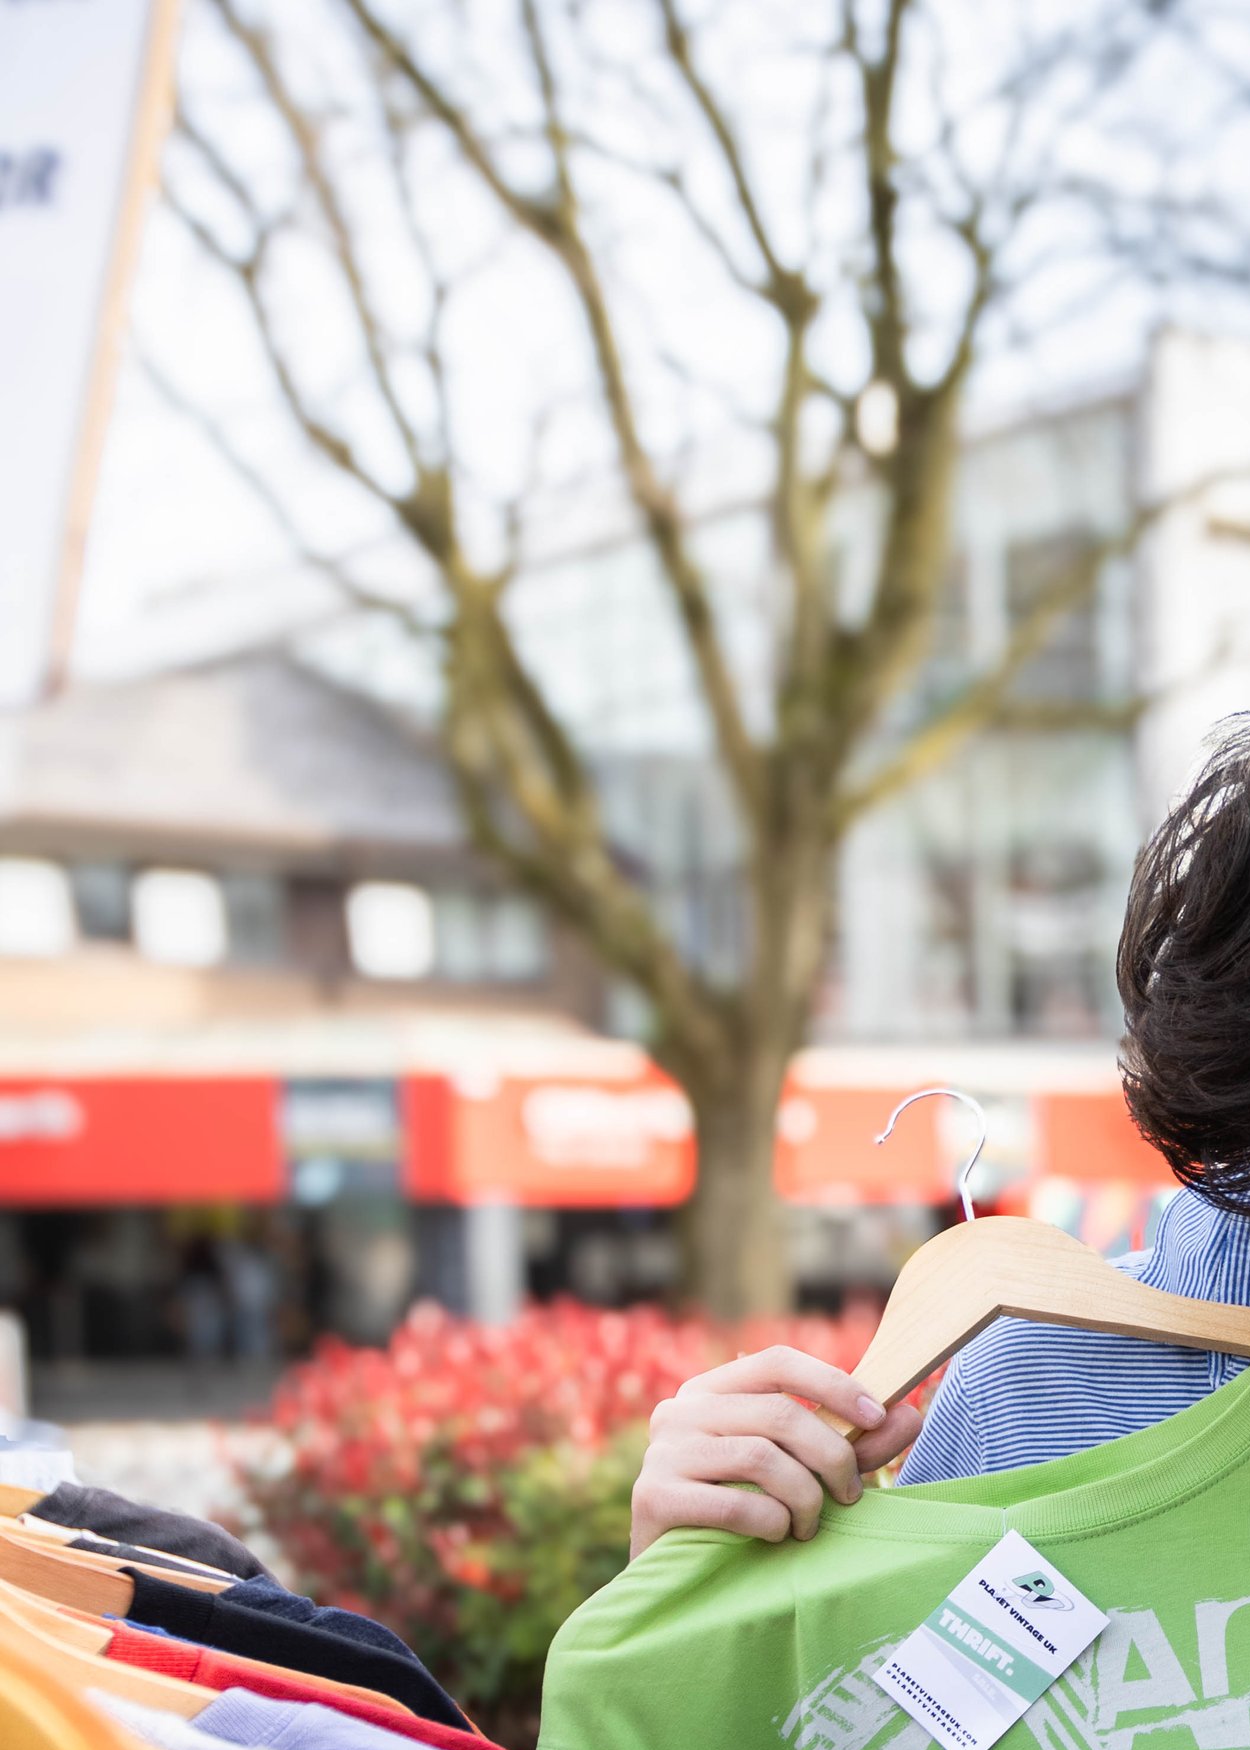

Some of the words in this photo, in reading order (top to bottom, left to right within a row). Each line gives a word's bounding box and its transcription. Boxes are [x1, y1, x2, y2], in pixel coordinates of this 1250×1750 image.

[938, 1607, 1015, 1677] THRIFT.
[1009, 1607, 1045, 1643] VINTAGE
[1043, 1640, 1059, 1655] UK
[891, 1662, 978, 1747] PLANETVINTAGEUK.COM
